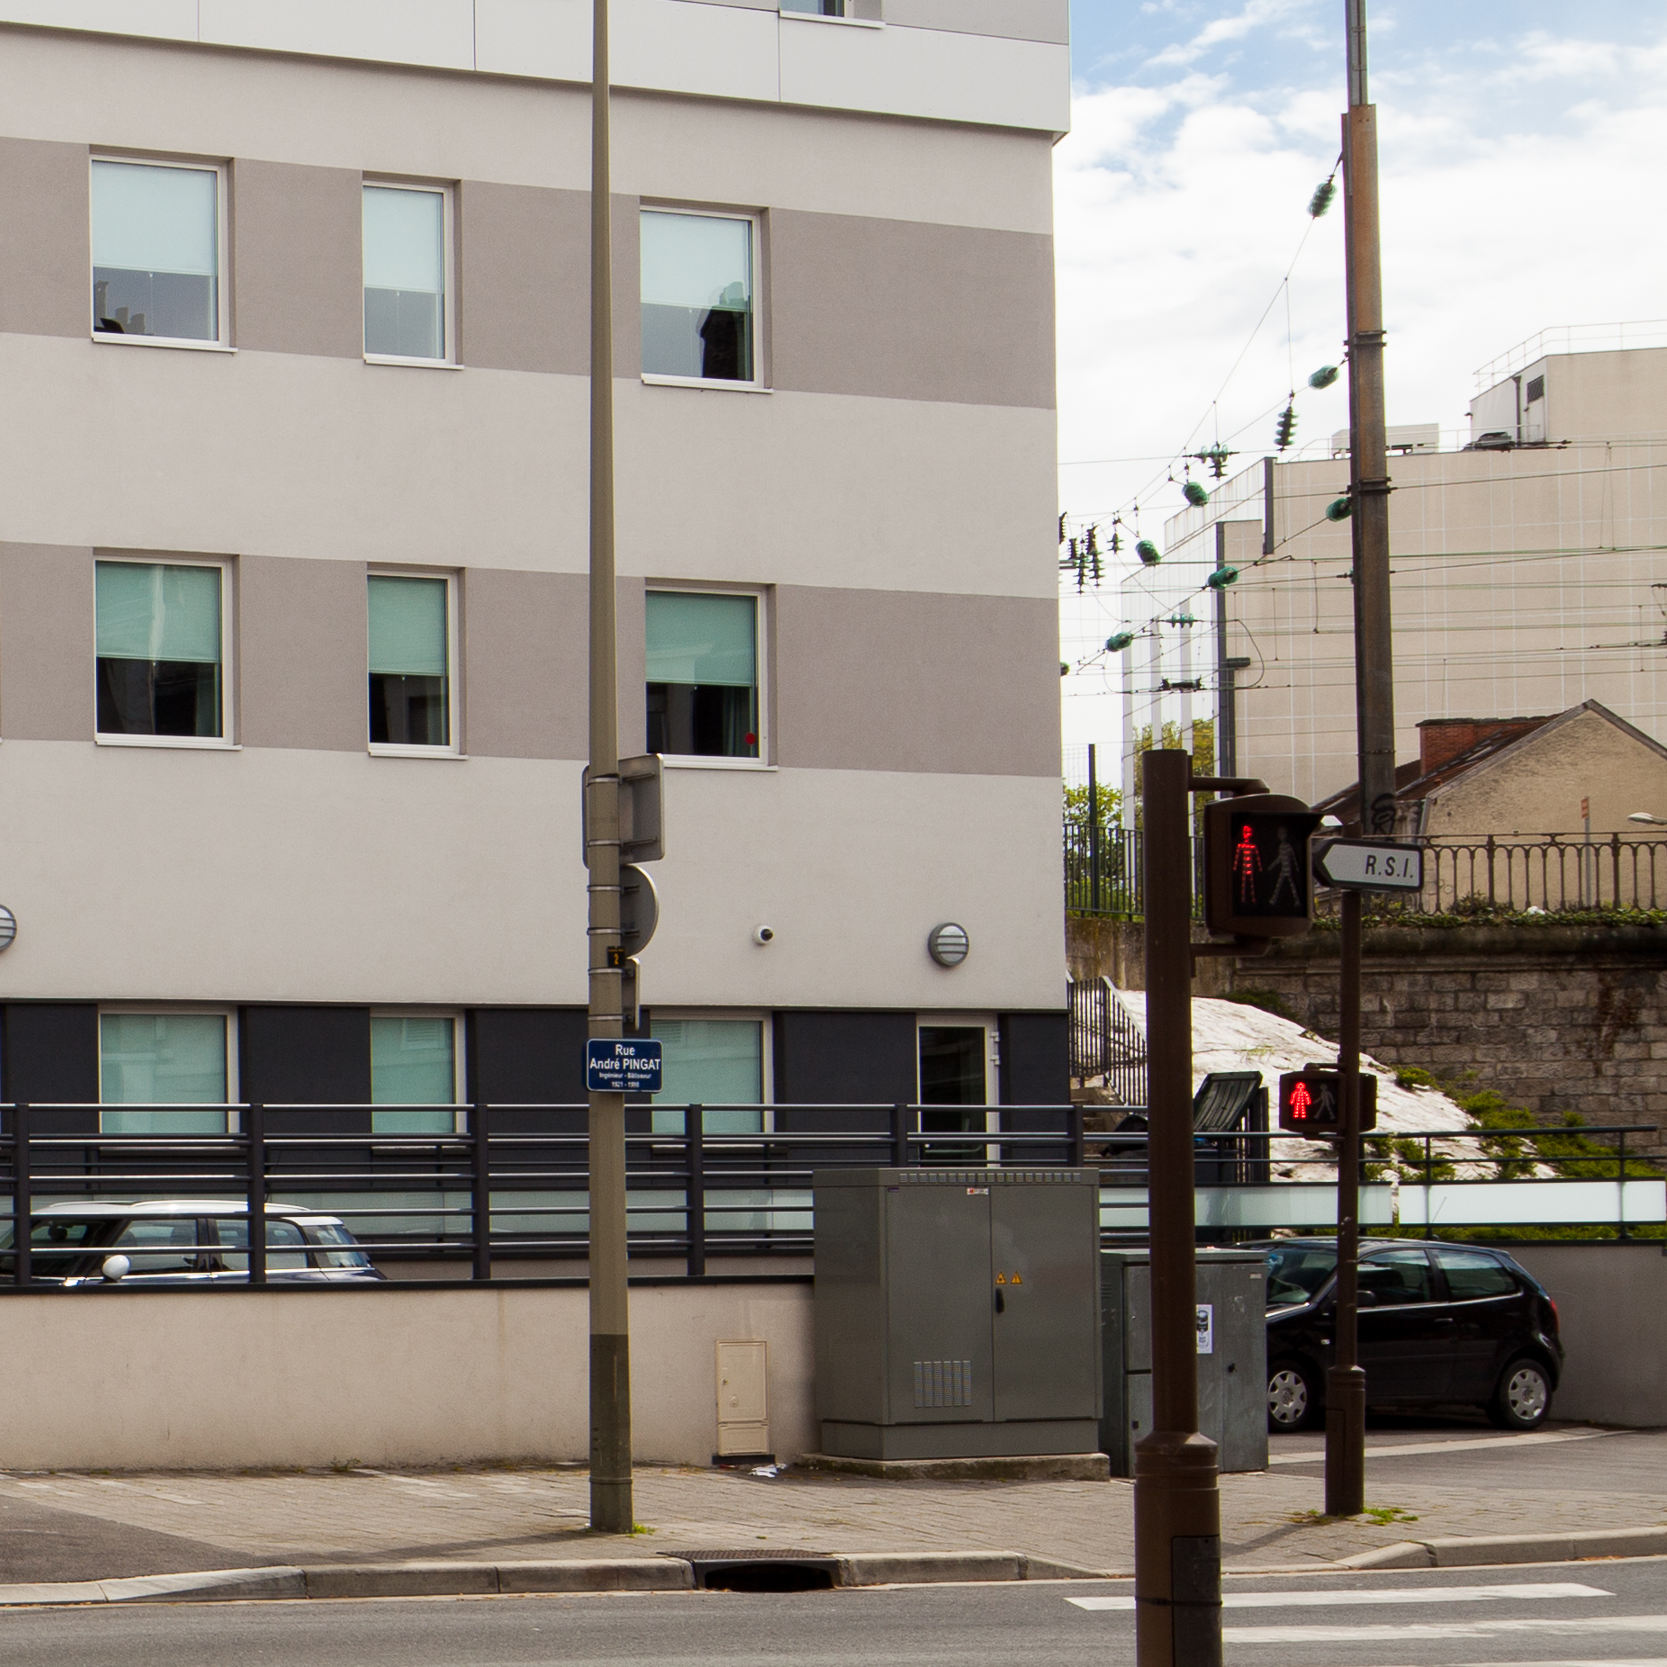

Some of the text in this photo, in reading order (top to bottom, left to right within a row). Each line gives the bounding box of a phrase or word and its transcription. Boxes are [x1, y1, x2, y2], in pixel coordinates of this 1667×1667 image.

[1364, 854, 1415, 879] R.S.I.
[615, 1044, 636, 1056] Rue
[589, 1057, 661, 1070] André PINGAT
